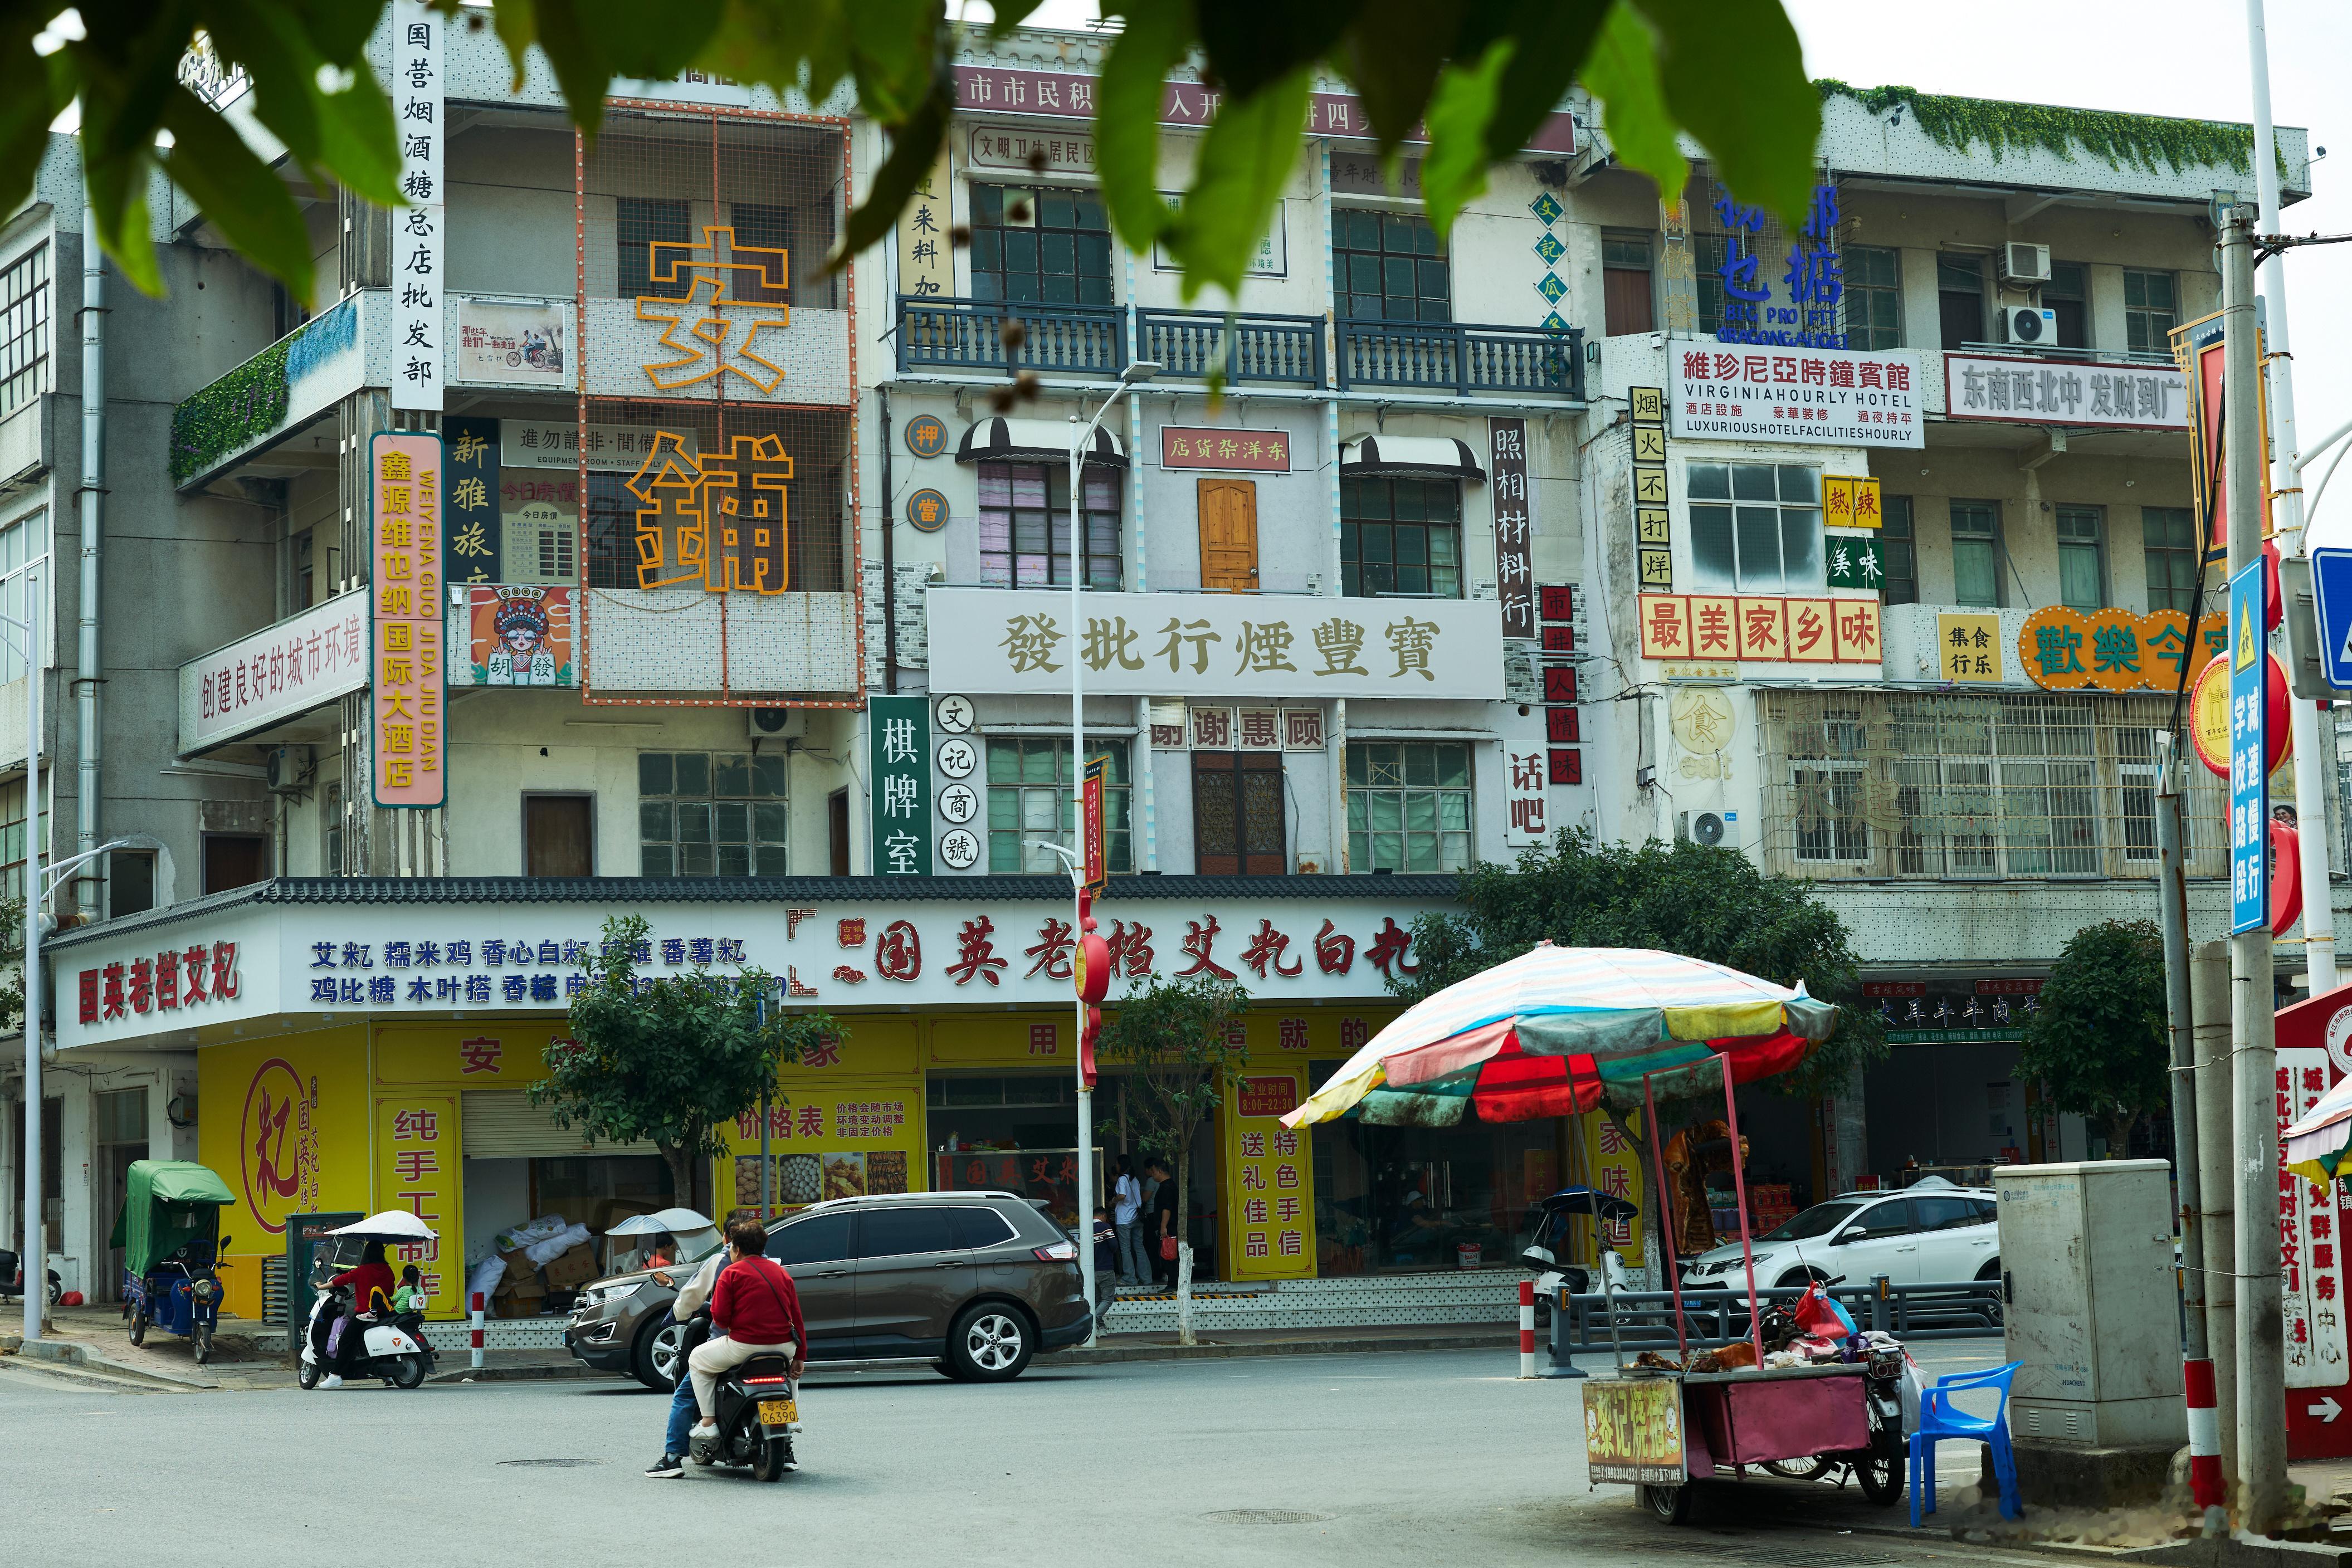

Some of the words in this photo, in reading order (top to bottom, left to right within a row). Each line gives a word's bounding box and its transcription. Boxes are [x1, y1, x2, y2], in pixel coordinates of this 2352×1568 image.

[401, 22, 434, 388] 国营烟酒糖总店批发部
[1683, 351, 1910, 392] 維珍尼亞時鐘賓館
[1686, 402, 1743, 417] 酒店設施
[1773, 406, 1829, 421] 豪華裝修
[1858, 409, 1912, 425] 過夜持平
[1856, 392, 1911, 408] HOTEL
[537, 456, 580, 465] EQUIPMEN
[1636, 393, 1670, 580] 烟火不打烊
[1829, 486, 1879, 520] 熱辣
[419, 469, 436, 566] WEIYENA
[523, 510, 558, 520] 今日房價
[1496, 428, 1531, 628] 照相材料行
[1833, 546, 1882, 581] 美味
[380, 451, 414, 788] 鑫源维也纳国际大酒店
[1648, 602, 1876, 655] 最美家乡味
[201, 613, 360, 720] 创建良好的城市环境
[1546, 591, 1578, 778] 市井人情味
[1151, 711, 1321, 747] 谢谢惠顾
[1678, 695, 1726, 743] 食
[882, 718, 920, 876] 棋牌室
[1509, 753, 1545, 834] 话吧
[2234, 695, 2246, 905] 学校路段
[2247, 686, 2260, 902] 减速慢行
[384, 940, 473, 968] 糯米鸡
[842, 933, 863, 941] 美食
[311, 976, 396, 1004] 鸡比糖
[736, 1105, 824, 1141] 价格表
[836, 1102, 904, 1114] 价格会随市场
[836, 1113, 905, 1126] 环境变动调整
[836, 1126, 894, 1138] 非固定价格
[1240, 1131, 1269, 1258] 送礼佳品
[1273, 1130, 1302, 1257] 特色手信
